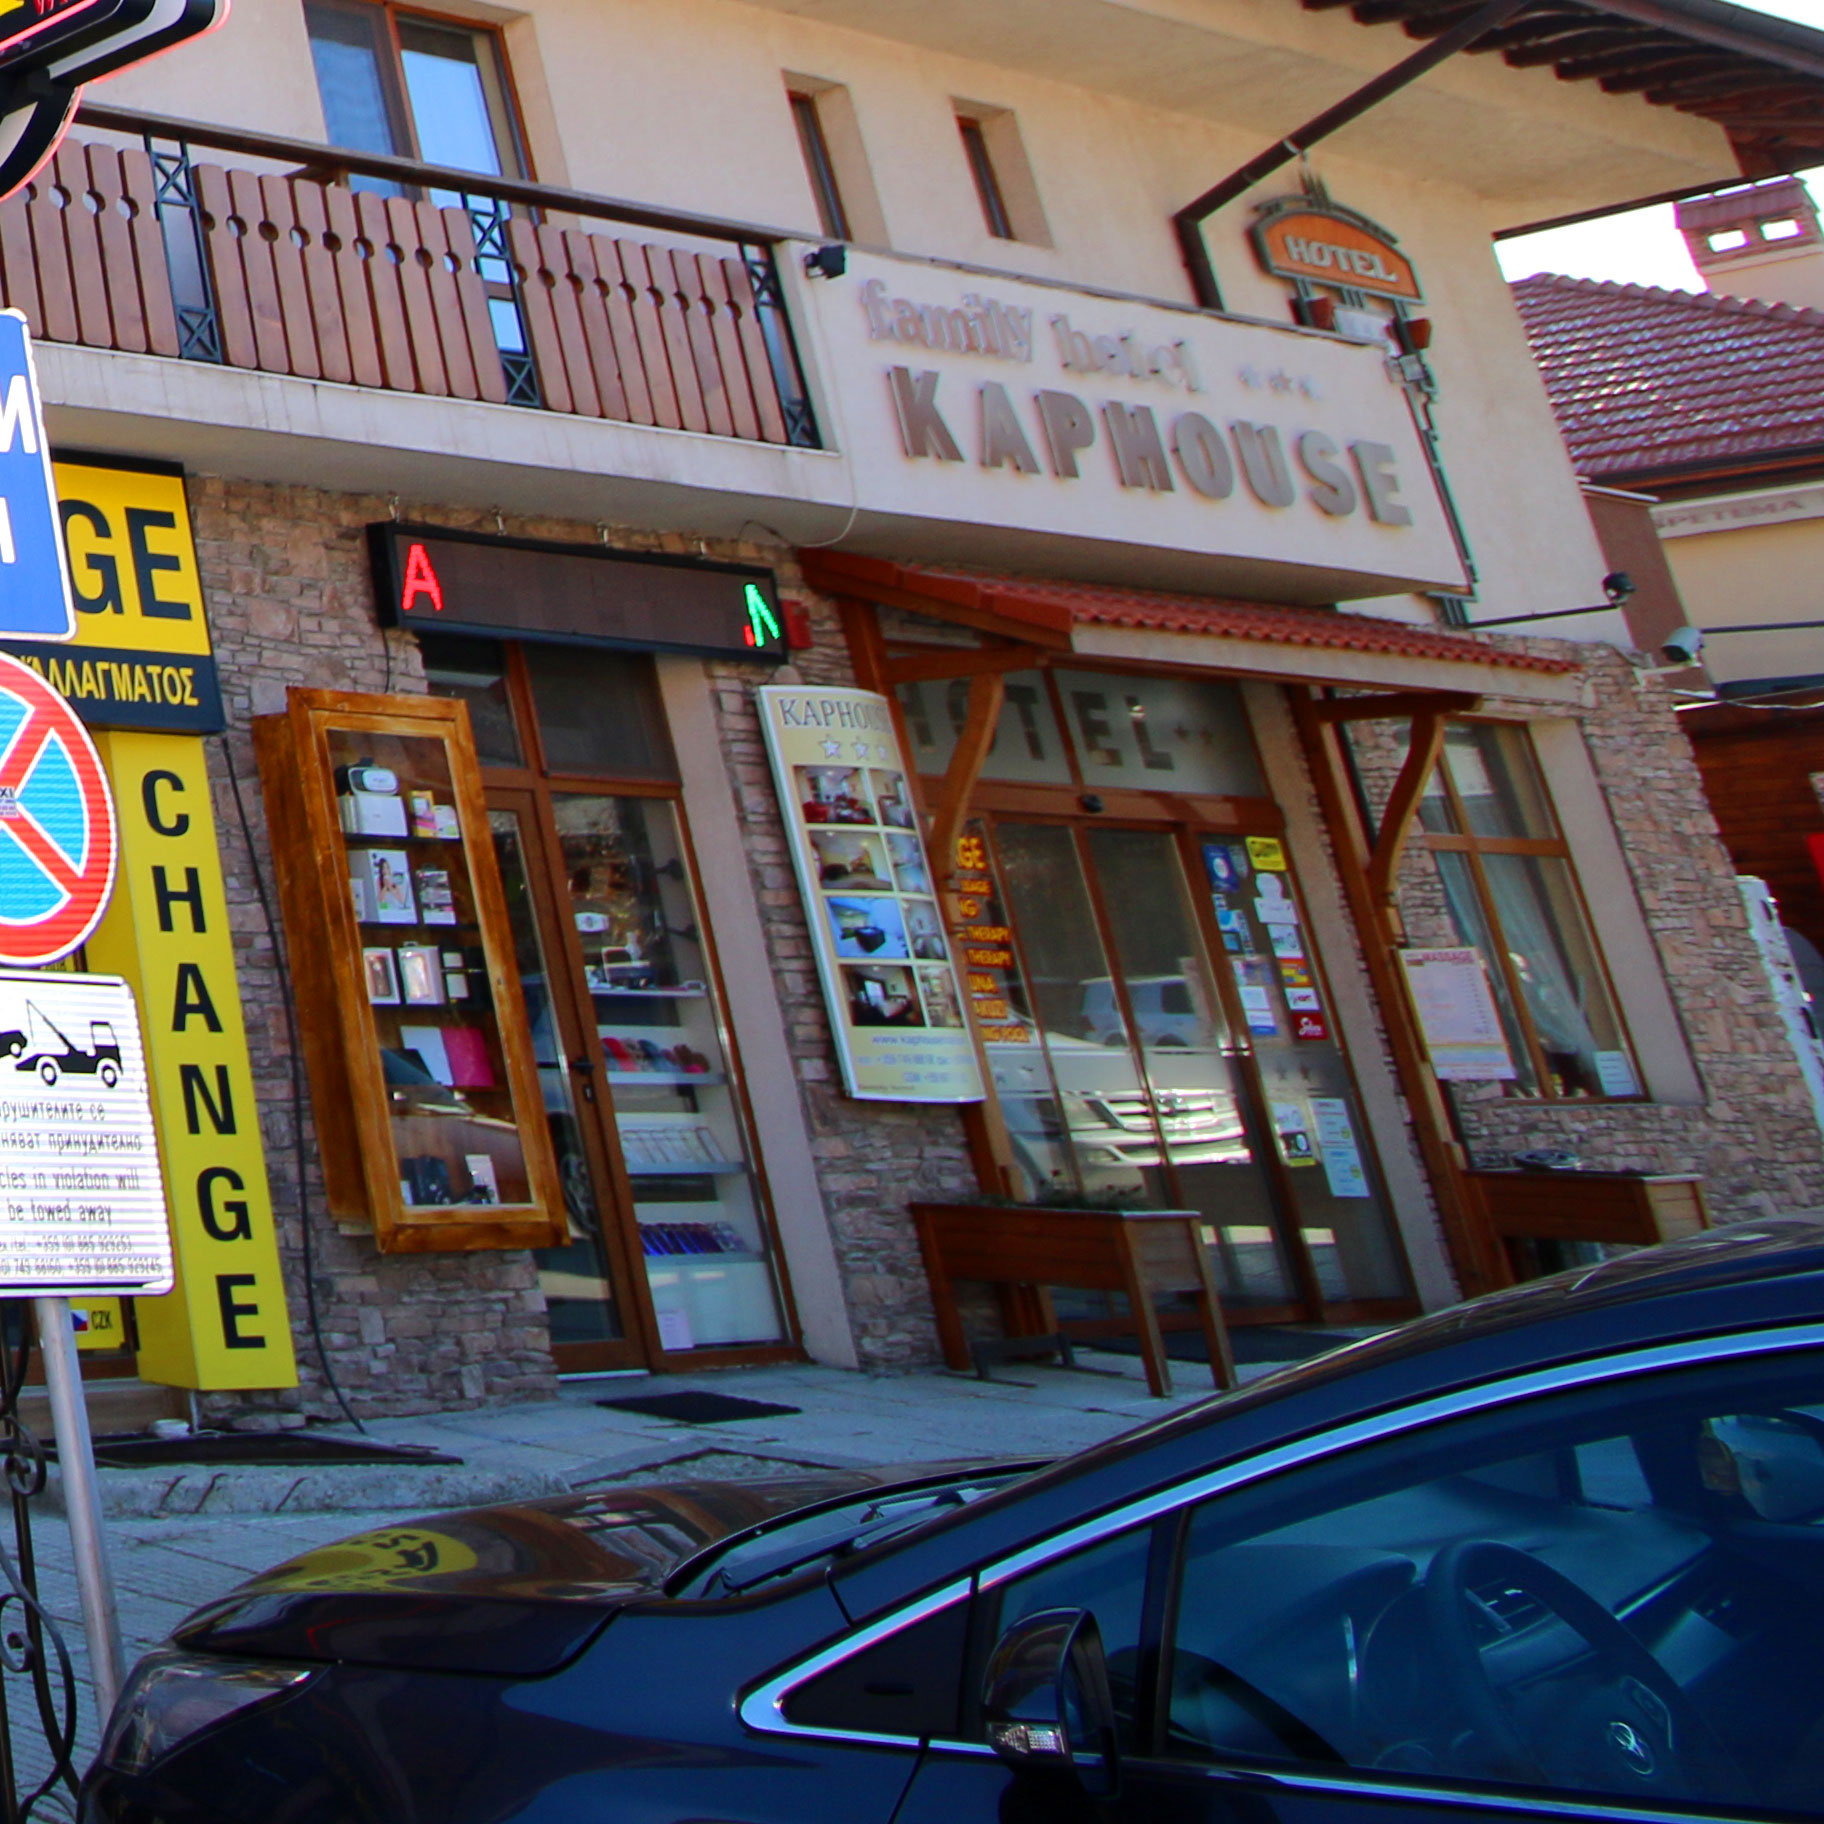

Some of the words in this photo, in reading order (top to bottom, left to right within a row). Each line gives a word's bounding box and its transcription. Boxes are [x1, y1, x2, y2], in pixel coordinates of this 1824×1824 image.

[1284, 234, 1399, 284] HOTEL
[860, 277, 1034, 364] family
[887, 364, 1414, 528] KAPHOUSE
[140, 767, 267, 1351] CHANGE
[89, 1102, 106, 1122] се
[48, 1132, 143, 1157] принудително
[32, 1166, 48, 1190] in
[52, 1166, 111, 1191] violation
[115, 1167, 142, 1191] will
[6, 1197, 25, 1222] be
[30, 1197, 72, 1223] towed
[78, 1204, 113, 1227] away
[91, 1310, 113, 1330] CZK
